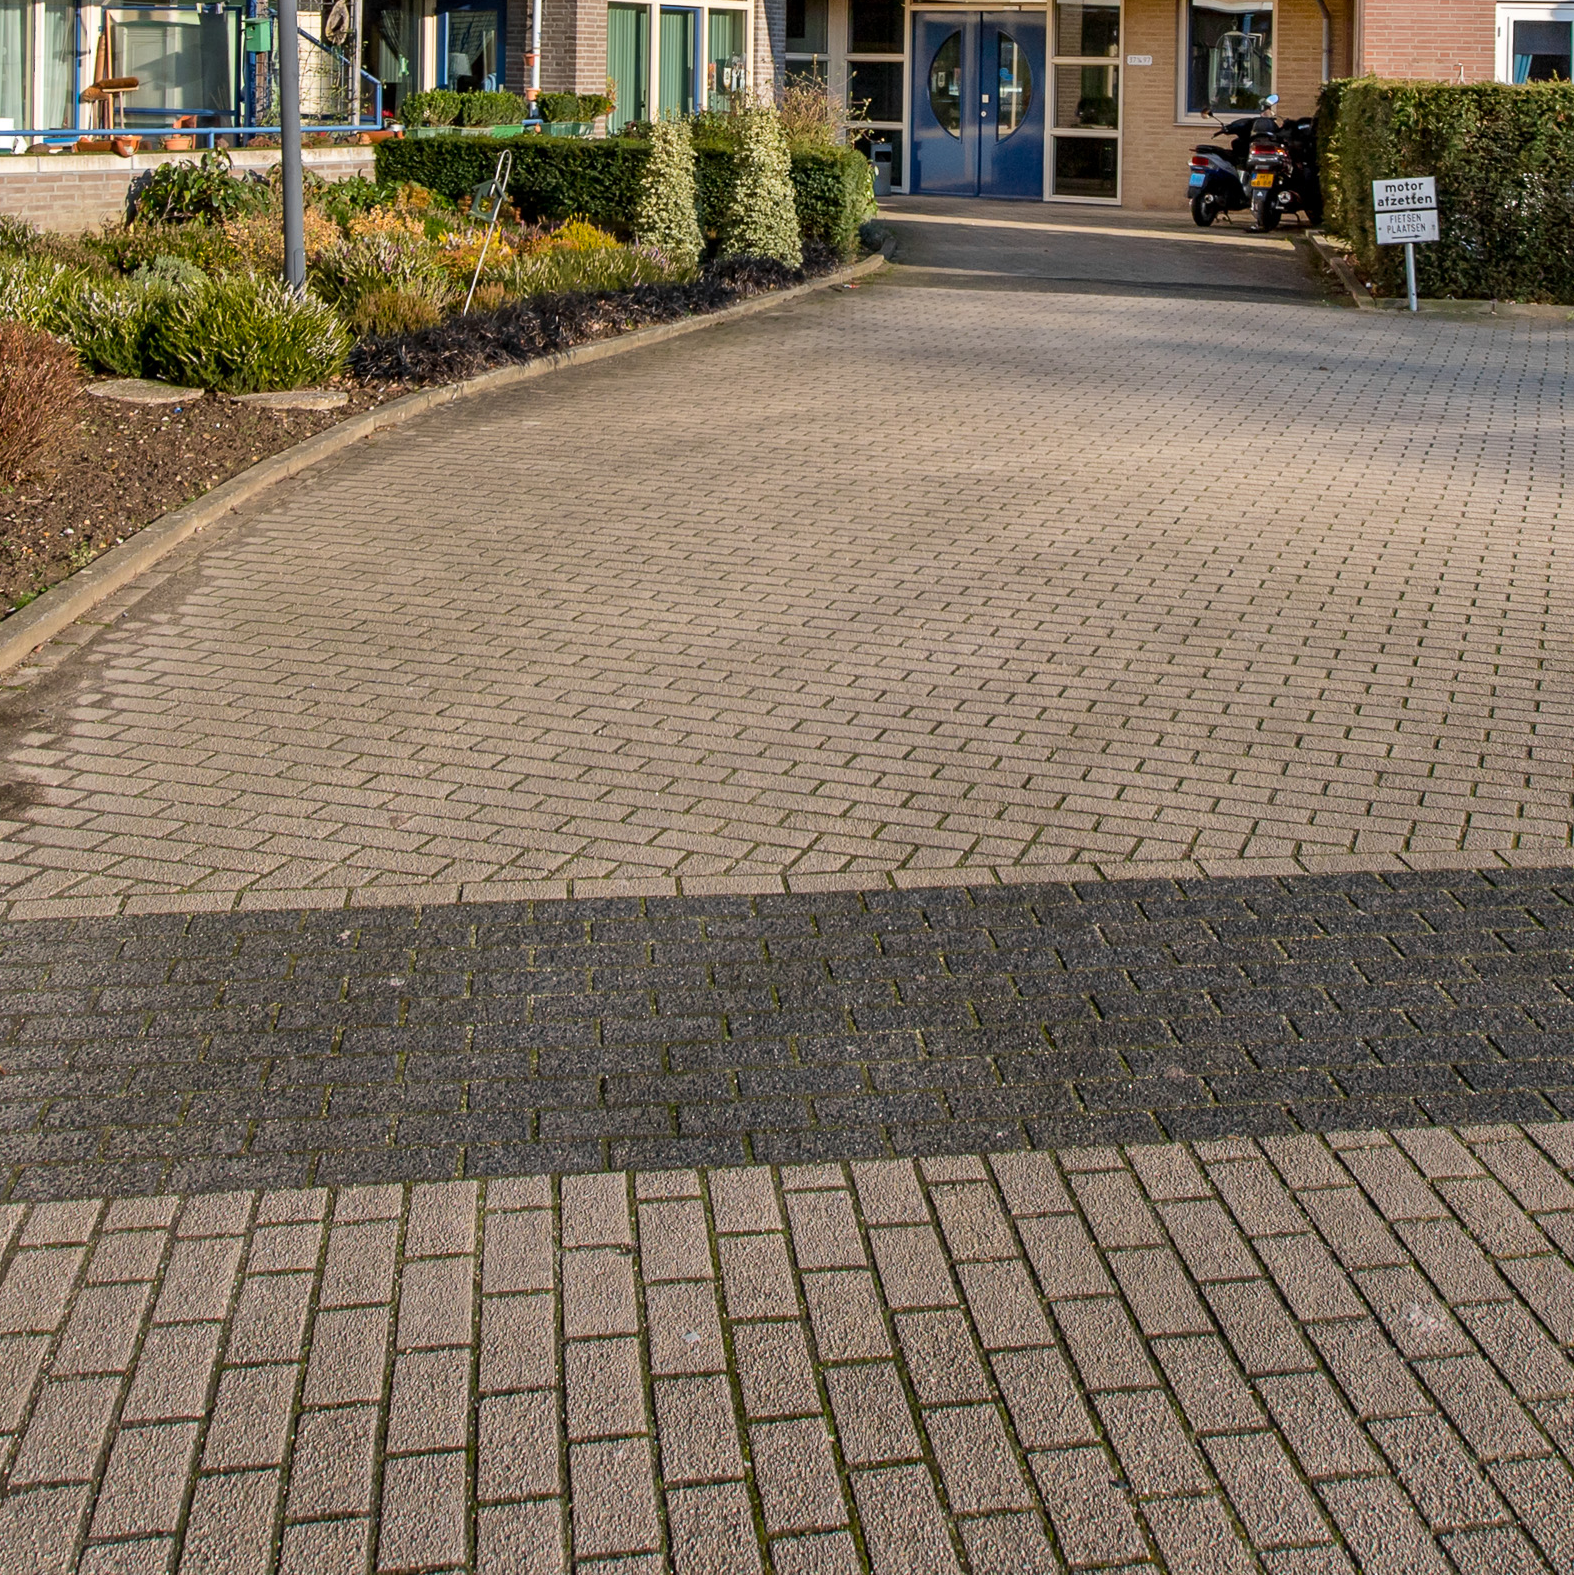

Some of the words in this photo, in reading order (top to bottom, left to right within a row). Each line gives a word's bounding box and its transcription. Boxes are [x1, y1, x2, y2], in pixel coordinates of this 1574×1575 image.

[1385, 181, 1424, 193] motor
[1377, 194, 1433, 207] afzetten
[1389, 213, 1422, 224] FIETSEN
[1387, 223, 1426, 234] PLAATSEN
